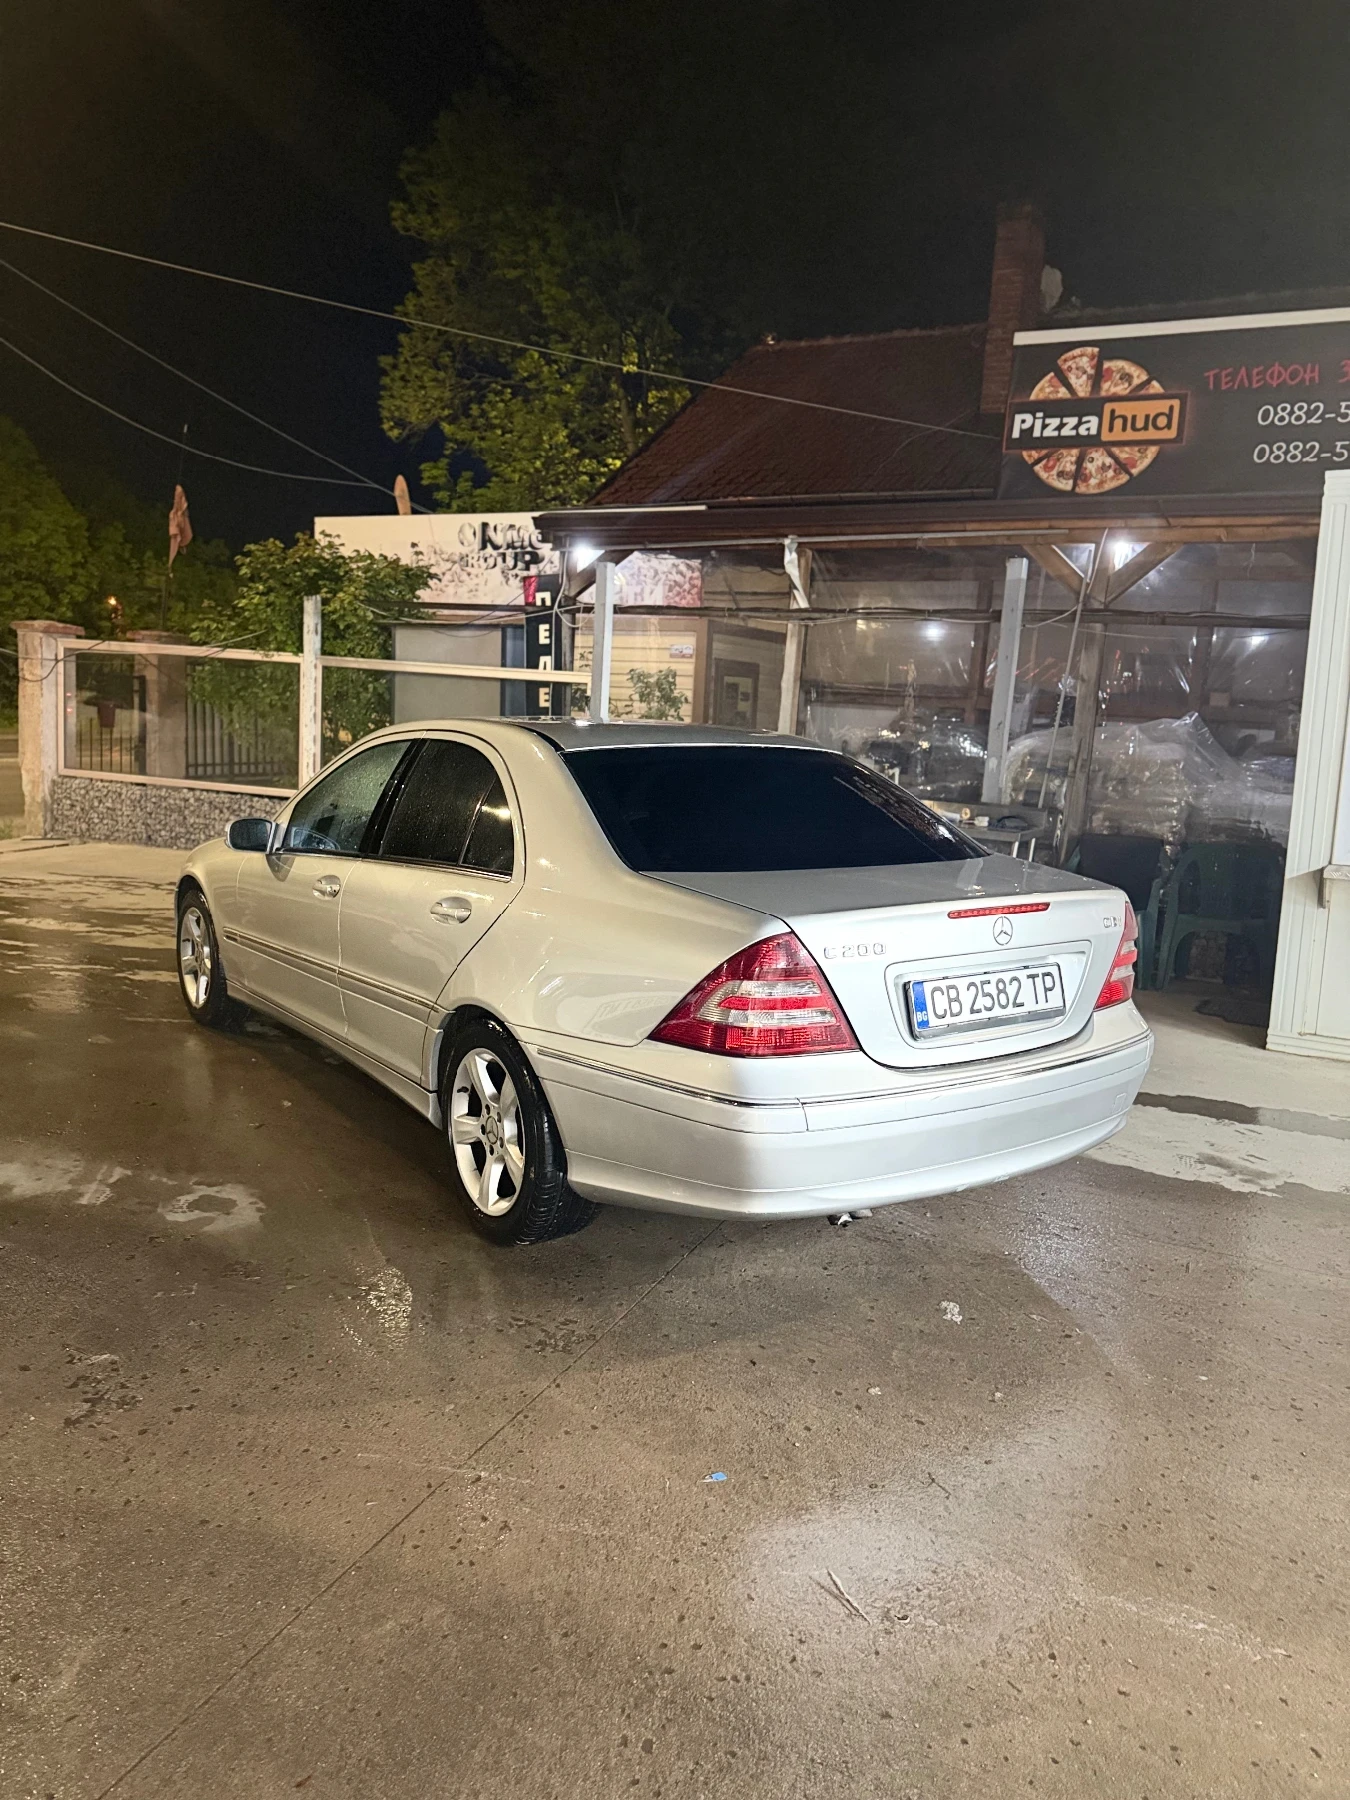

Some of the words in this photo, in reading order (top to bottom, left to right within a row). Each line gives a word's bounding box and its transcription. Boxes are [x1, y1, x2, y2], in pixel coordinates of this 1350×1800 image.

[1203, 361, 1320, 391] ТЕЛЕФОН
[1011, 412, 1099, 439] Pizza
[1107, 404, 1174, 434] hud
[1257, 401, 1350, 426] 0882-5
[1252, 441, 1350, 464] 0882-5
[930, 984, 963, 1020] CB
[966, 975, 1025, 1015] 2582
[1026, 971, 1056, 1005] TP
[916, 1011, 928, 1022] BG
